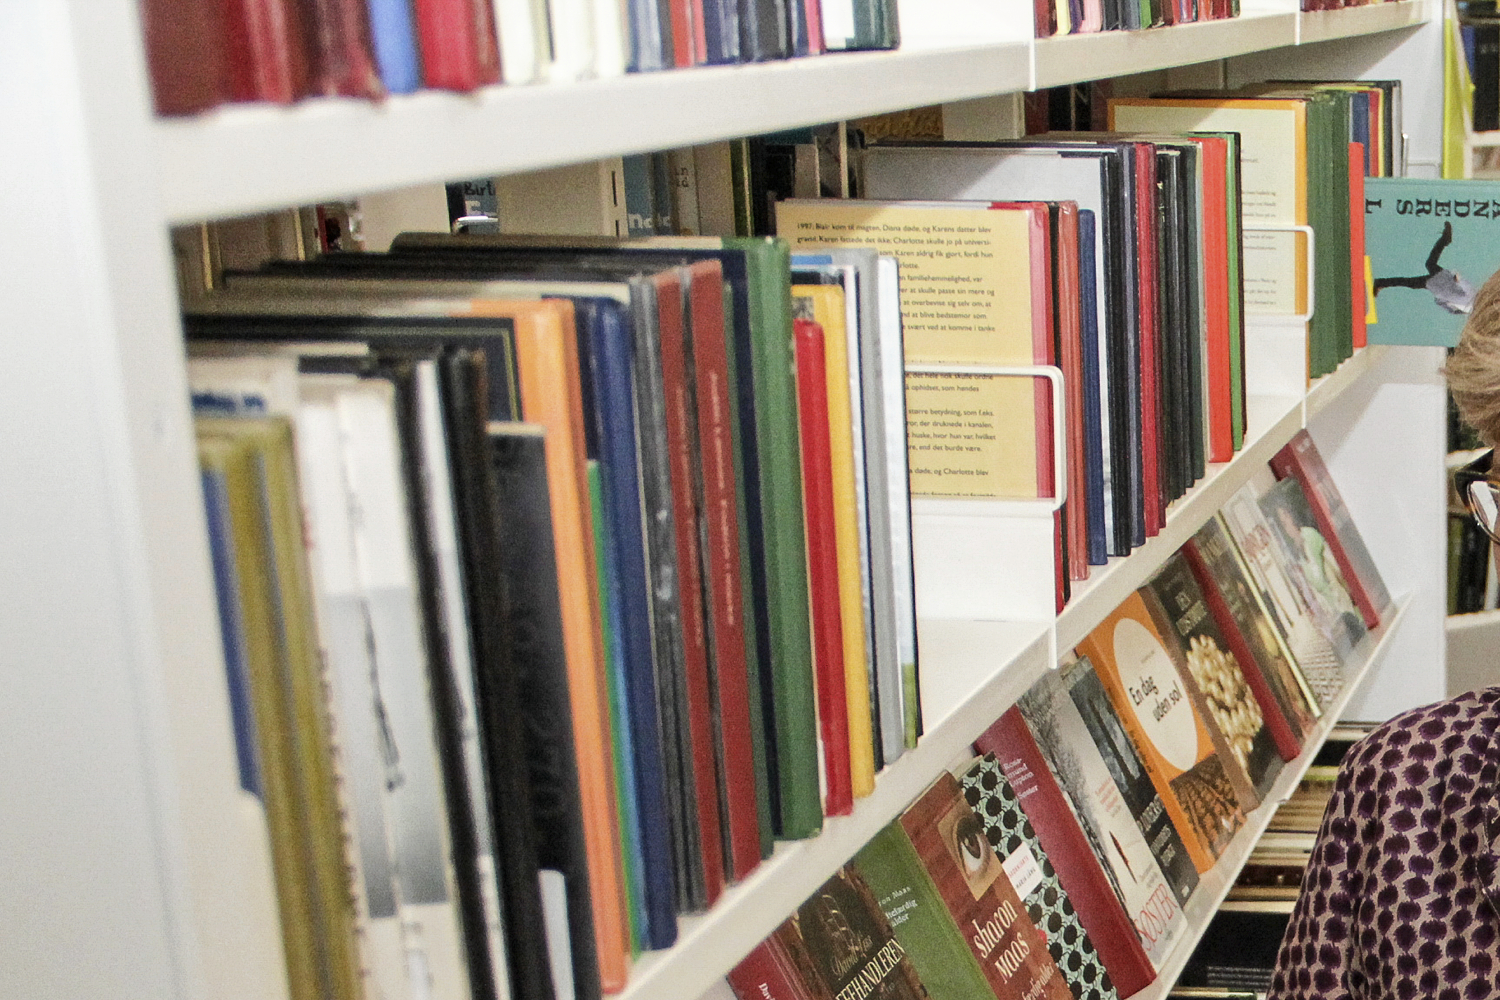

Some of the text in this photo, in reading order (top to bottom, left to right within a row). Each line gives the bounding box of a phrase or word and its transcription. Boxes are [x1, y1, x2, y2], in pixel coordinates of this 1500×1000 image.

[1129, 676, 1159, 706] En dag
[1152, 680, 1183, 722] uden sol
[971, 900, 1018, 959] sharon
[1133, 883, 1178, 951] SØSTER
